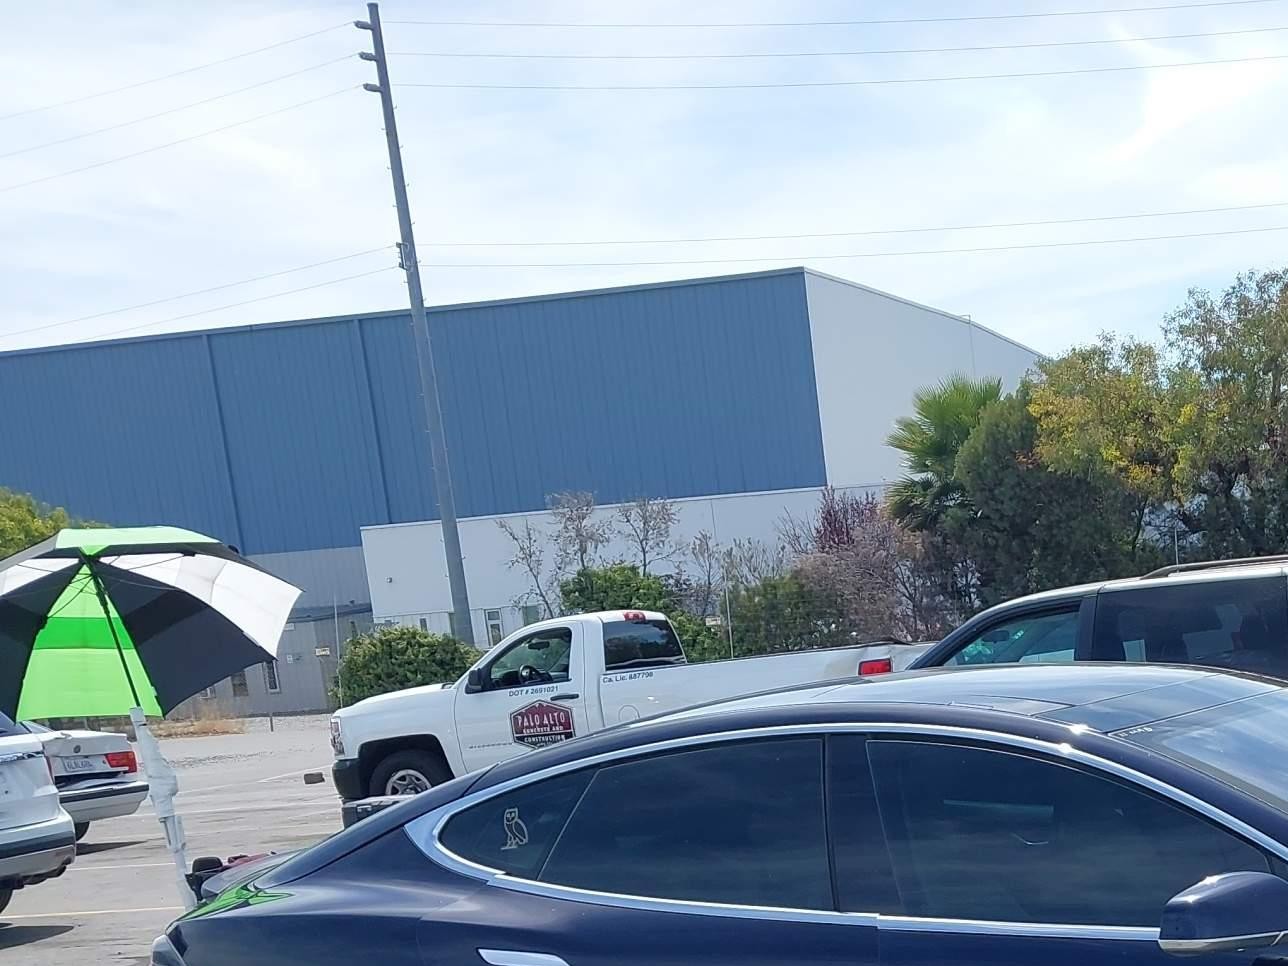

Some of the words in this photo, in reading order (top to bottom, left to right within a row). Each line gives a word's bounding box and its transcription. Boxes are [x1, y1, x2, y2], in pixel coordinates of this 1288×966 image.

[508, 689, 525, 697] DOT
[530, 685, 558, 695] 2691021
[515, 713, 540, 727] PALO
[543, 711, 565, 726] ALTO
[524, 735, 566, 743] CONSTRUCTION
